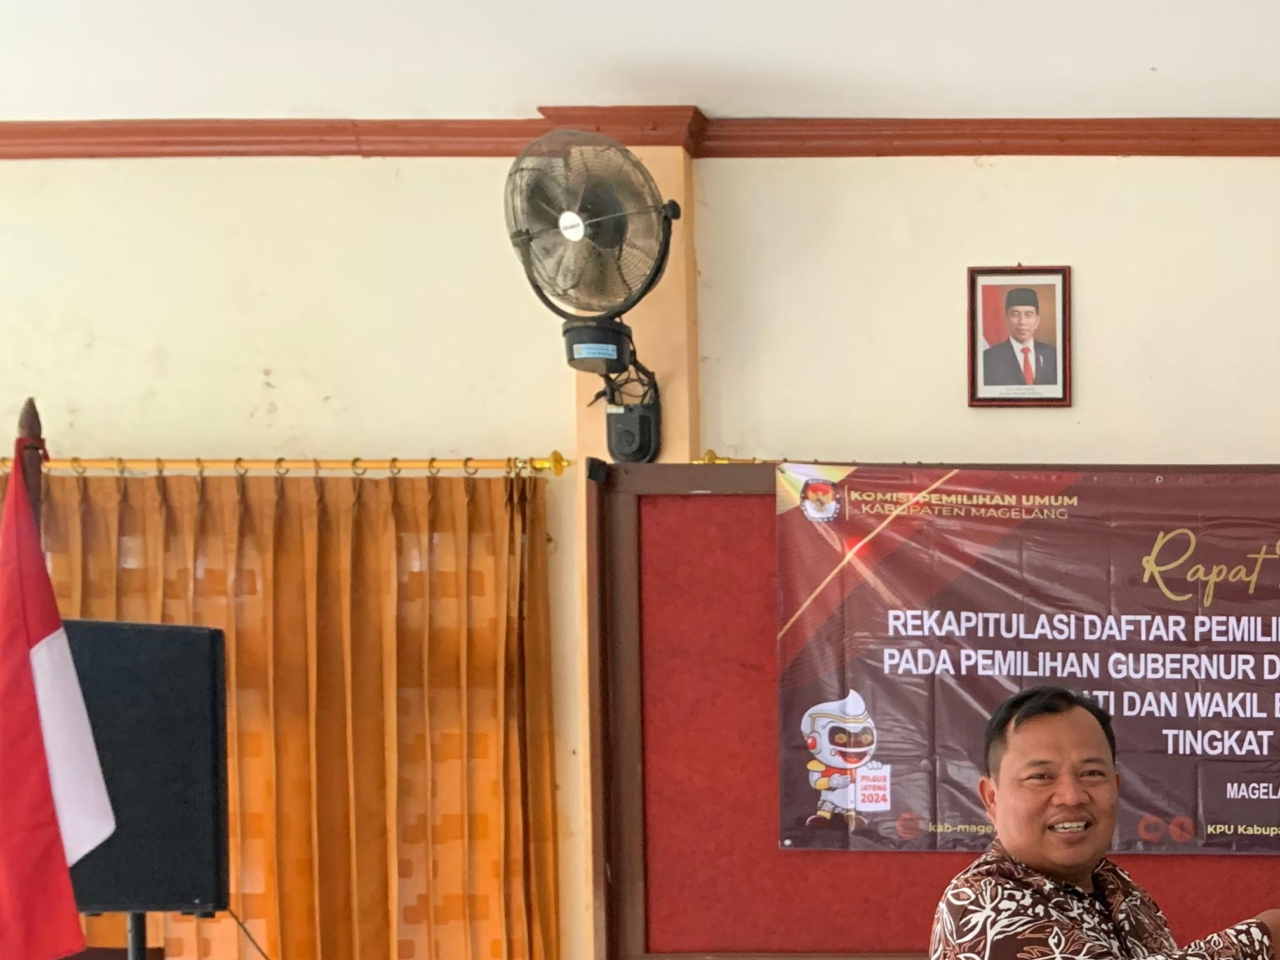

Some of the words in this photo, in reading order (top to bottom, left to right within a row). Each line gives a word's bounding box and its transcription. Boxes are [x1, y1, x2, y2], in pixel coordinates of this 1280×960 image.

[850, 490, 916, 503] KOMISI
[919, 492, 1016, 507] PEMILIHAN
[1022, 494, 1078, 507] UMUM
[861, 503, 965, 517] KABUPATEN
[971, 508, 1068, 520] MAGELANG
[1142, 528, 1280, 608] Rapat
[888, 610, 1076, 640] REKAPITULASI
[1084, 615, 1187, 641] DAFTAR
[883, 649, 955, 675] PADA
[960, 650, 1100, 679] PEMILIHAN
[1108, 652, 1256, 680] GUBERNUR
[1123, 691, 1177, 717] DAN
[1185, 692, 1267, 718] WAKIL
[1162, 729, 1273, 756] TINGKAT
[861, 775, 887, 783] PILGUB
[861, 793, 888, 803] 2024
[929, 822, 997, 835] kab-mage
[1206, 824, 1235, 835] KPU
